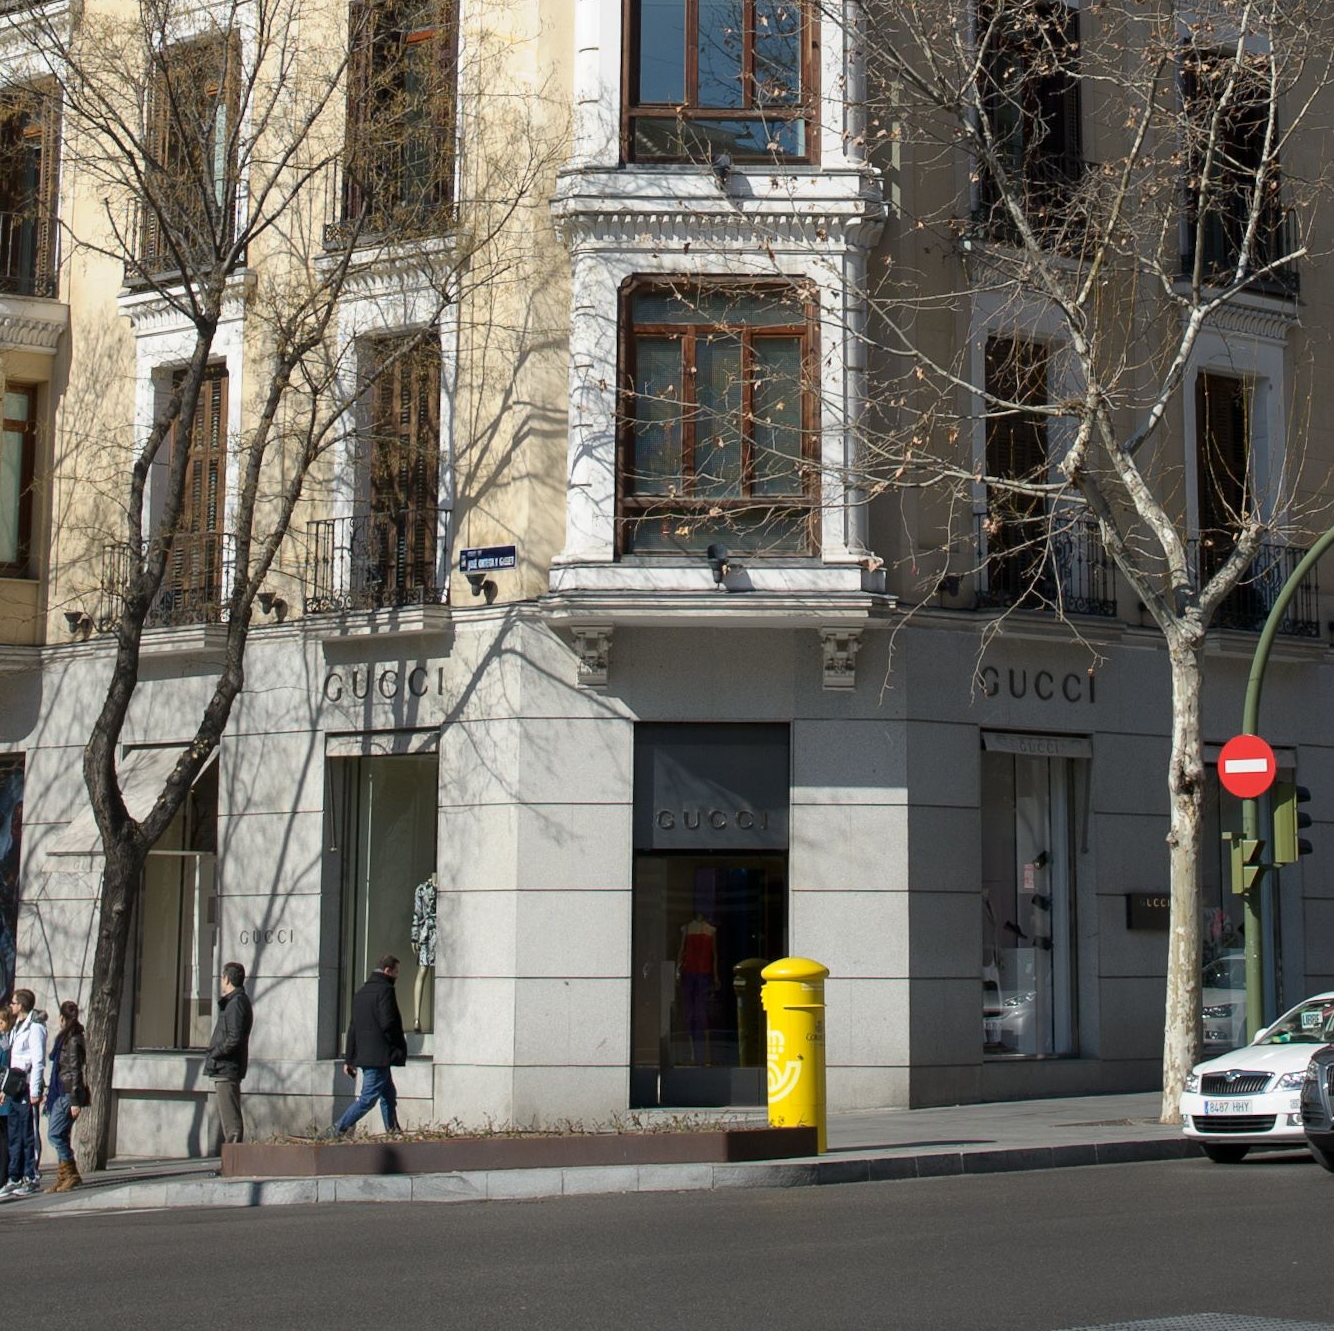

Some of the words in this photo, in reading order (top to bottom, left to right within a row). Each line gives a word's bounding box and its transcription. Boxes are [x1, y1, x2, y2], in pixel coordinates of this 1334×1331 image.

[323, 667, 444, 703] GUCCI
[981, 666, 1095, 704] GUCCI
[1019, 739, 1059, 755] GUCCI
[656, 809, 770, 831] GUCCI
[240, 930, 294, 945] GUCCI
[1209, 1102, 1229, 1113] 8487
